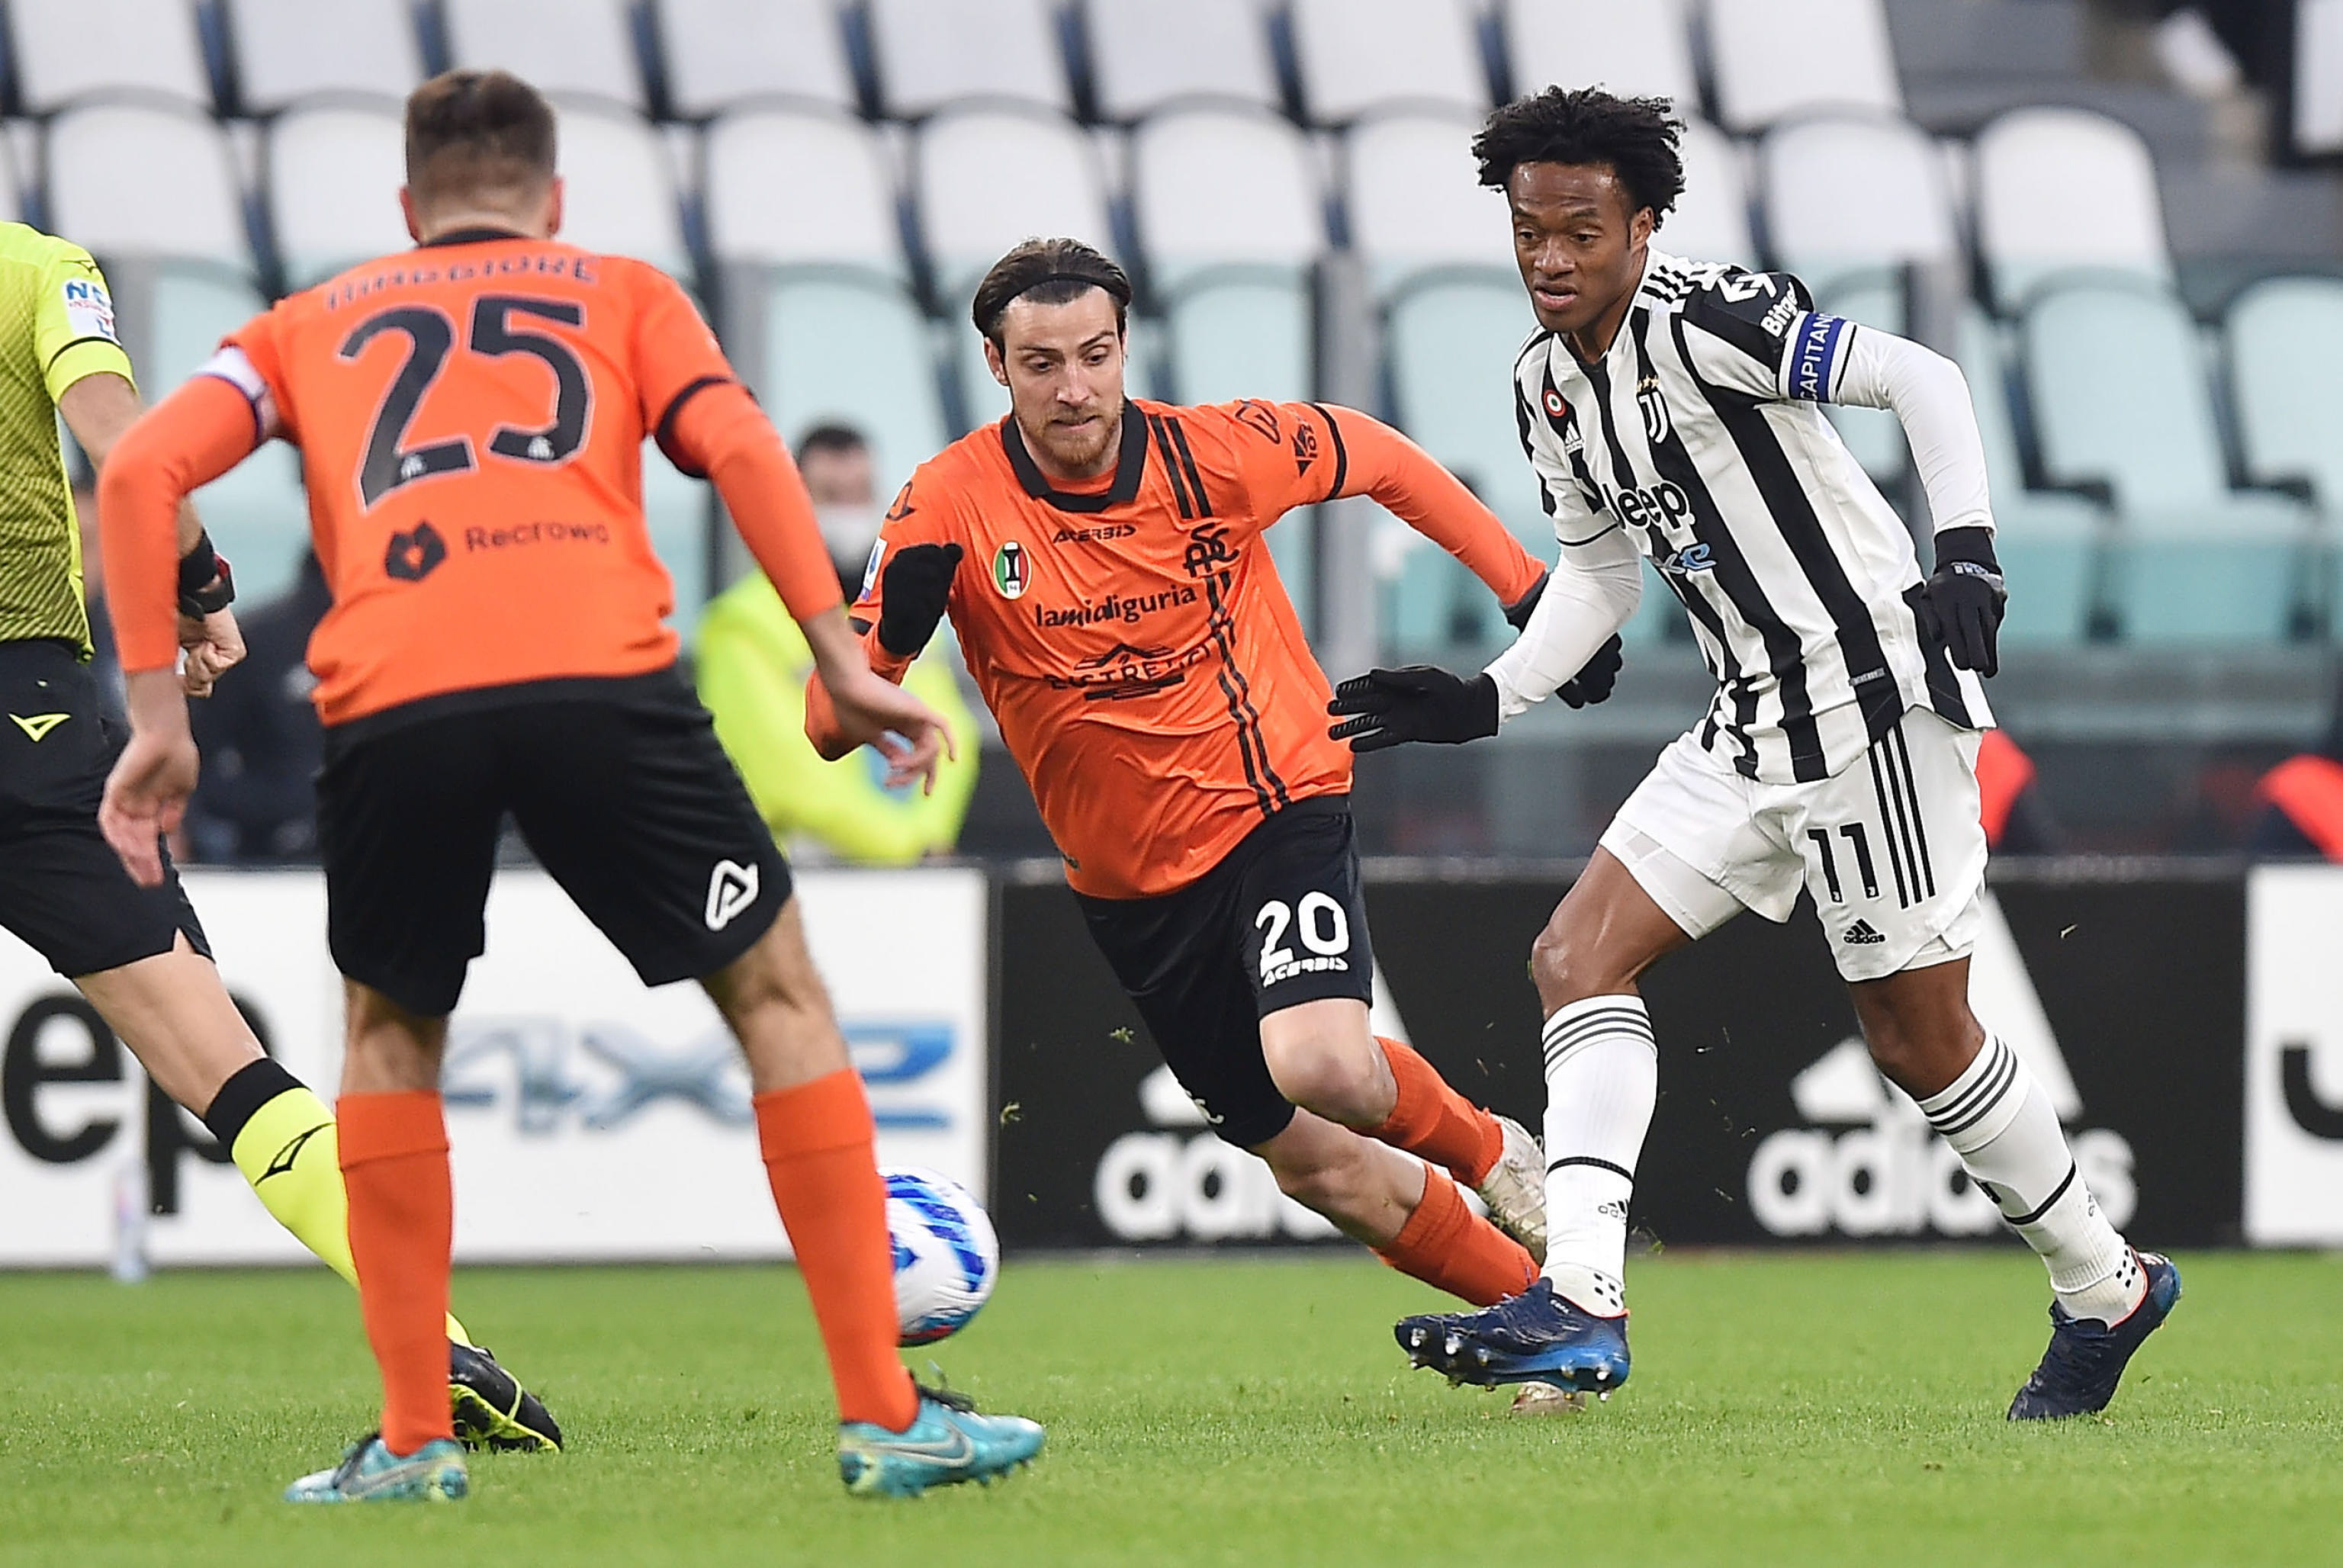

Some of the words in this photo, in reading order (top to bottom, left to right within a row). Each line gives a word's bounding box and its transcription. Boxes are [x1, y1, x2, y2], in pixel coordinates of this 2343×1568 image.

[1799, 312, 1836, 400] CAPITAN
[337, 294, 595, 515] 25
[1806, 822, 1880, 903] 11
[1255, 890, 1350, 978] 20
[1263, 956, 1349, 988] ACERBIS
[1843, 933, 1886, 945] adidas
